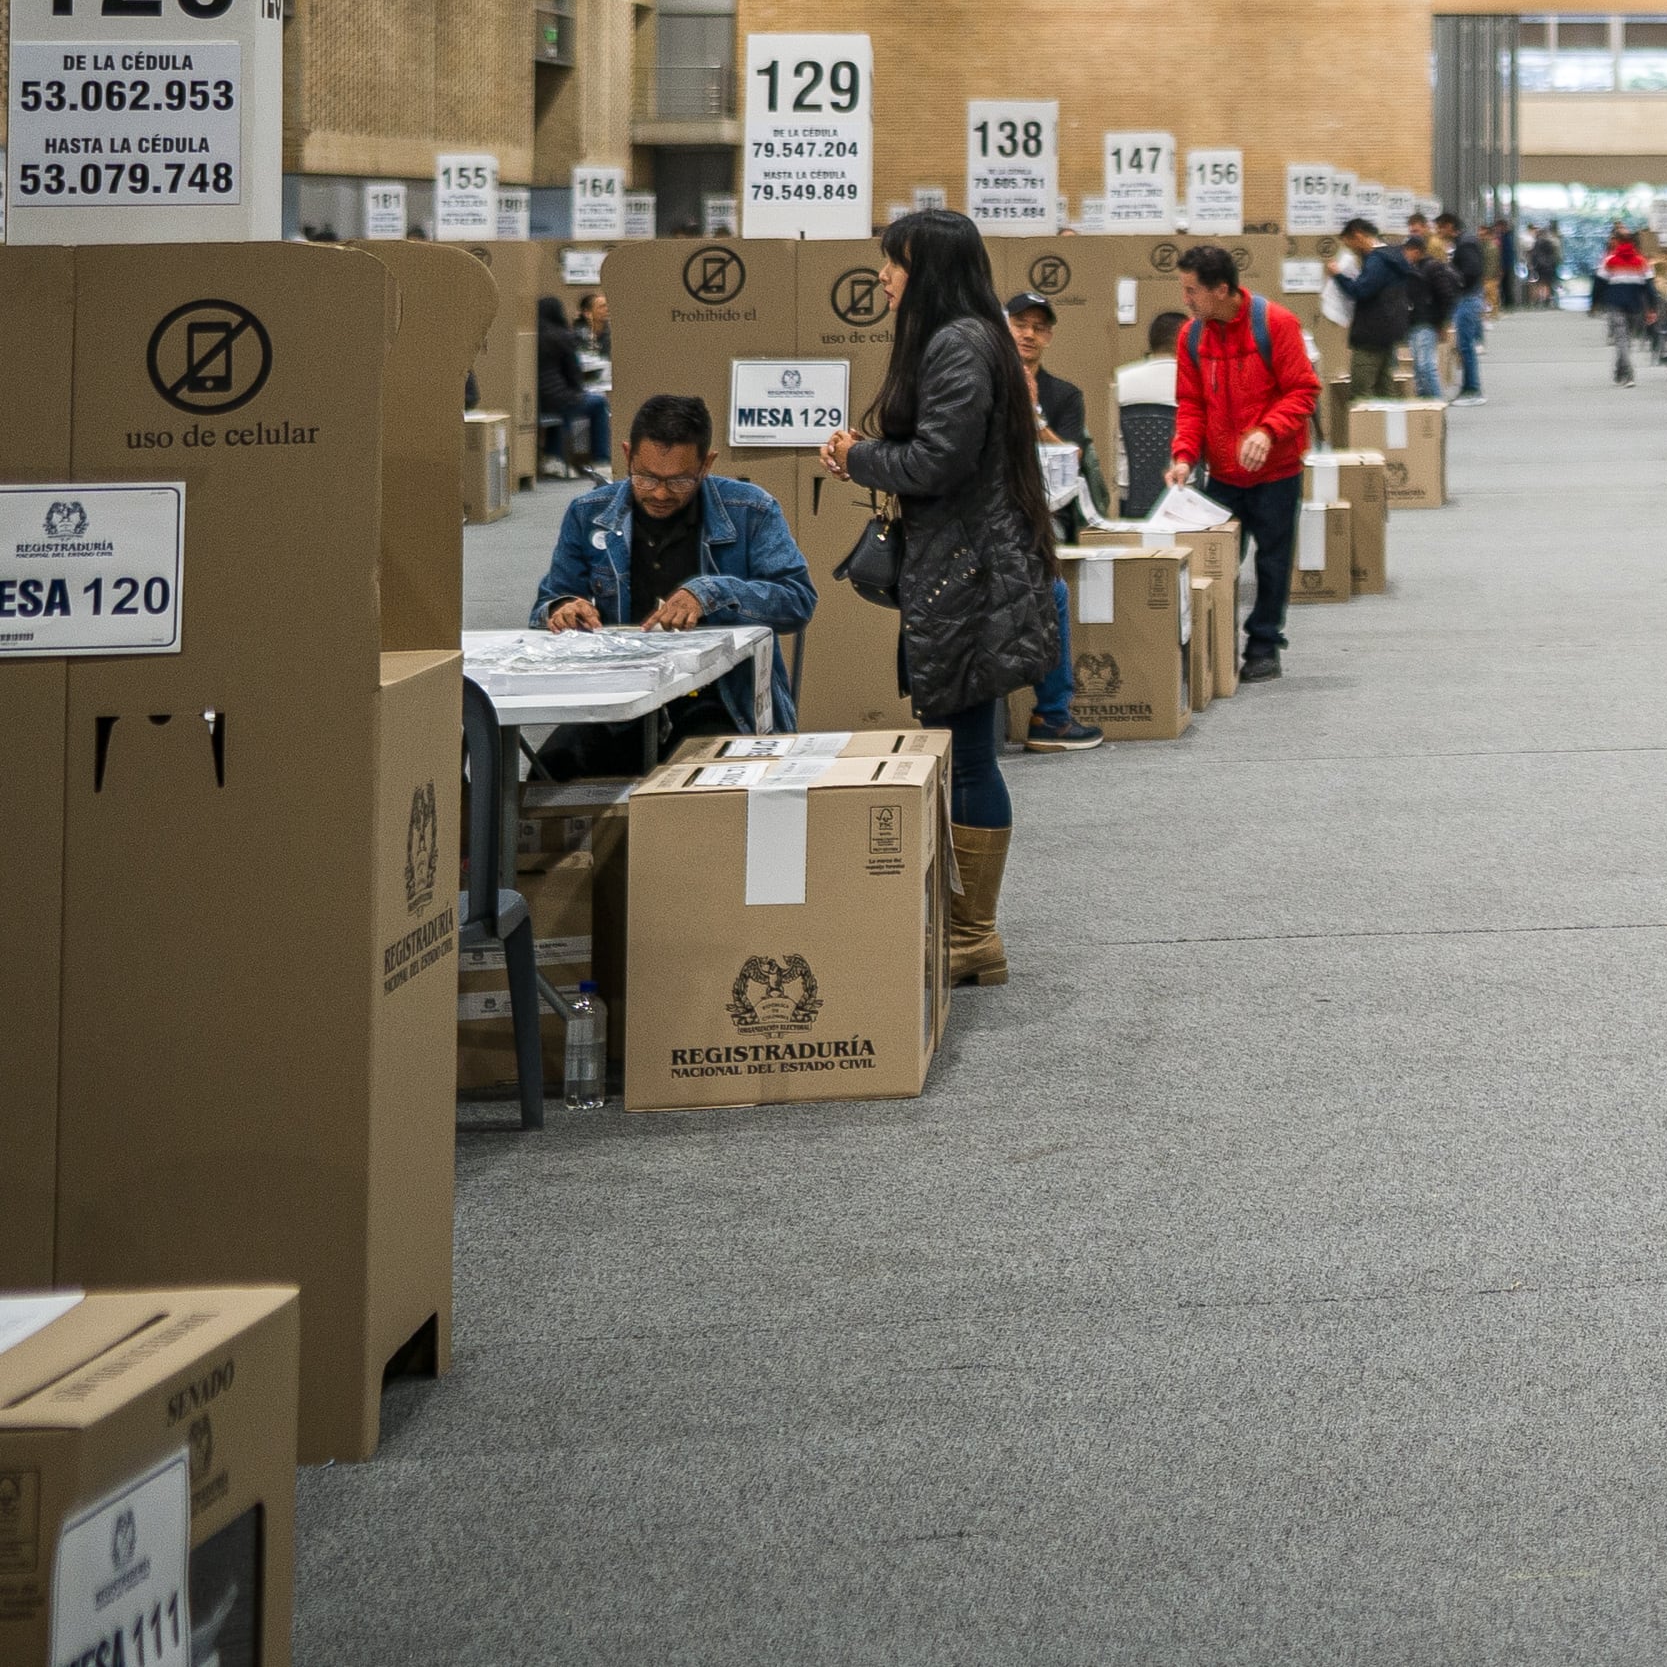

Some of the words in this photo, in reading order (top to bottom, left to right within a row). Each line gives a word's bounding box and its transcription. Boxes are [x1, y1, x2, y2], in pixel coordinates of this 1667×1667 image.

[63, 55, 88, 71] DE
[93, 54, 115, 70] LA
[120, 51, 193, 71] CÉDULA
[20, 79, 235, 112] 53.062.953
[756, 60, 860, 114] 129
[44, 138, 103, 154] HASTA
[109, 138, 133, 154] LA
[137, 134, 210, 154] CÉDULA
[752, 142, 858, 158] 79.547.204
[973, 120, 1042, 158] 138
[1111, 147, 1161, 174] 147
[19, 163, 234, 195] 53.079.748
[442, 167, 487, 190] 155
[1196, 163, 1239, 185] 156
[751, 184, 858, 200] 79.549.849
[1331, 183, 1350, 197] 74
[671, 308, 741, 323] Prohibido
[744, 308, 757, 322] el
[821, 333, 848, 345] uso
[850, 330, 867, 344] de
[870, 330, 895, 343] celu
[738, 408, 794, 427] MESA
[800, 408, 842, 428] 129
[126, 429, 174, 450] uso
[182, 424, 217, 448] de
[226, 422, 320, 447] celular
[16, 540, 115, 554] REGISTRADURÍA
[0, 578, 71, 618] ESA
[83, 576, 170, 616] 120
[1072, 702, 1153, 716] STRADURÍA
[384, 901, 455, 976] REGISTRADURÍA
[671, 1035, 875, 1066] REGISTRADURÍA
[671, 1066, 742, 1079] NACIONAL
[747, 1065, 775, 1075] DEL
[780, 1061, 836, 1073] ESTADO
[840, 1059, 876, 1069] CIVIL
[167, 1357, 235, 1428] SENADO
